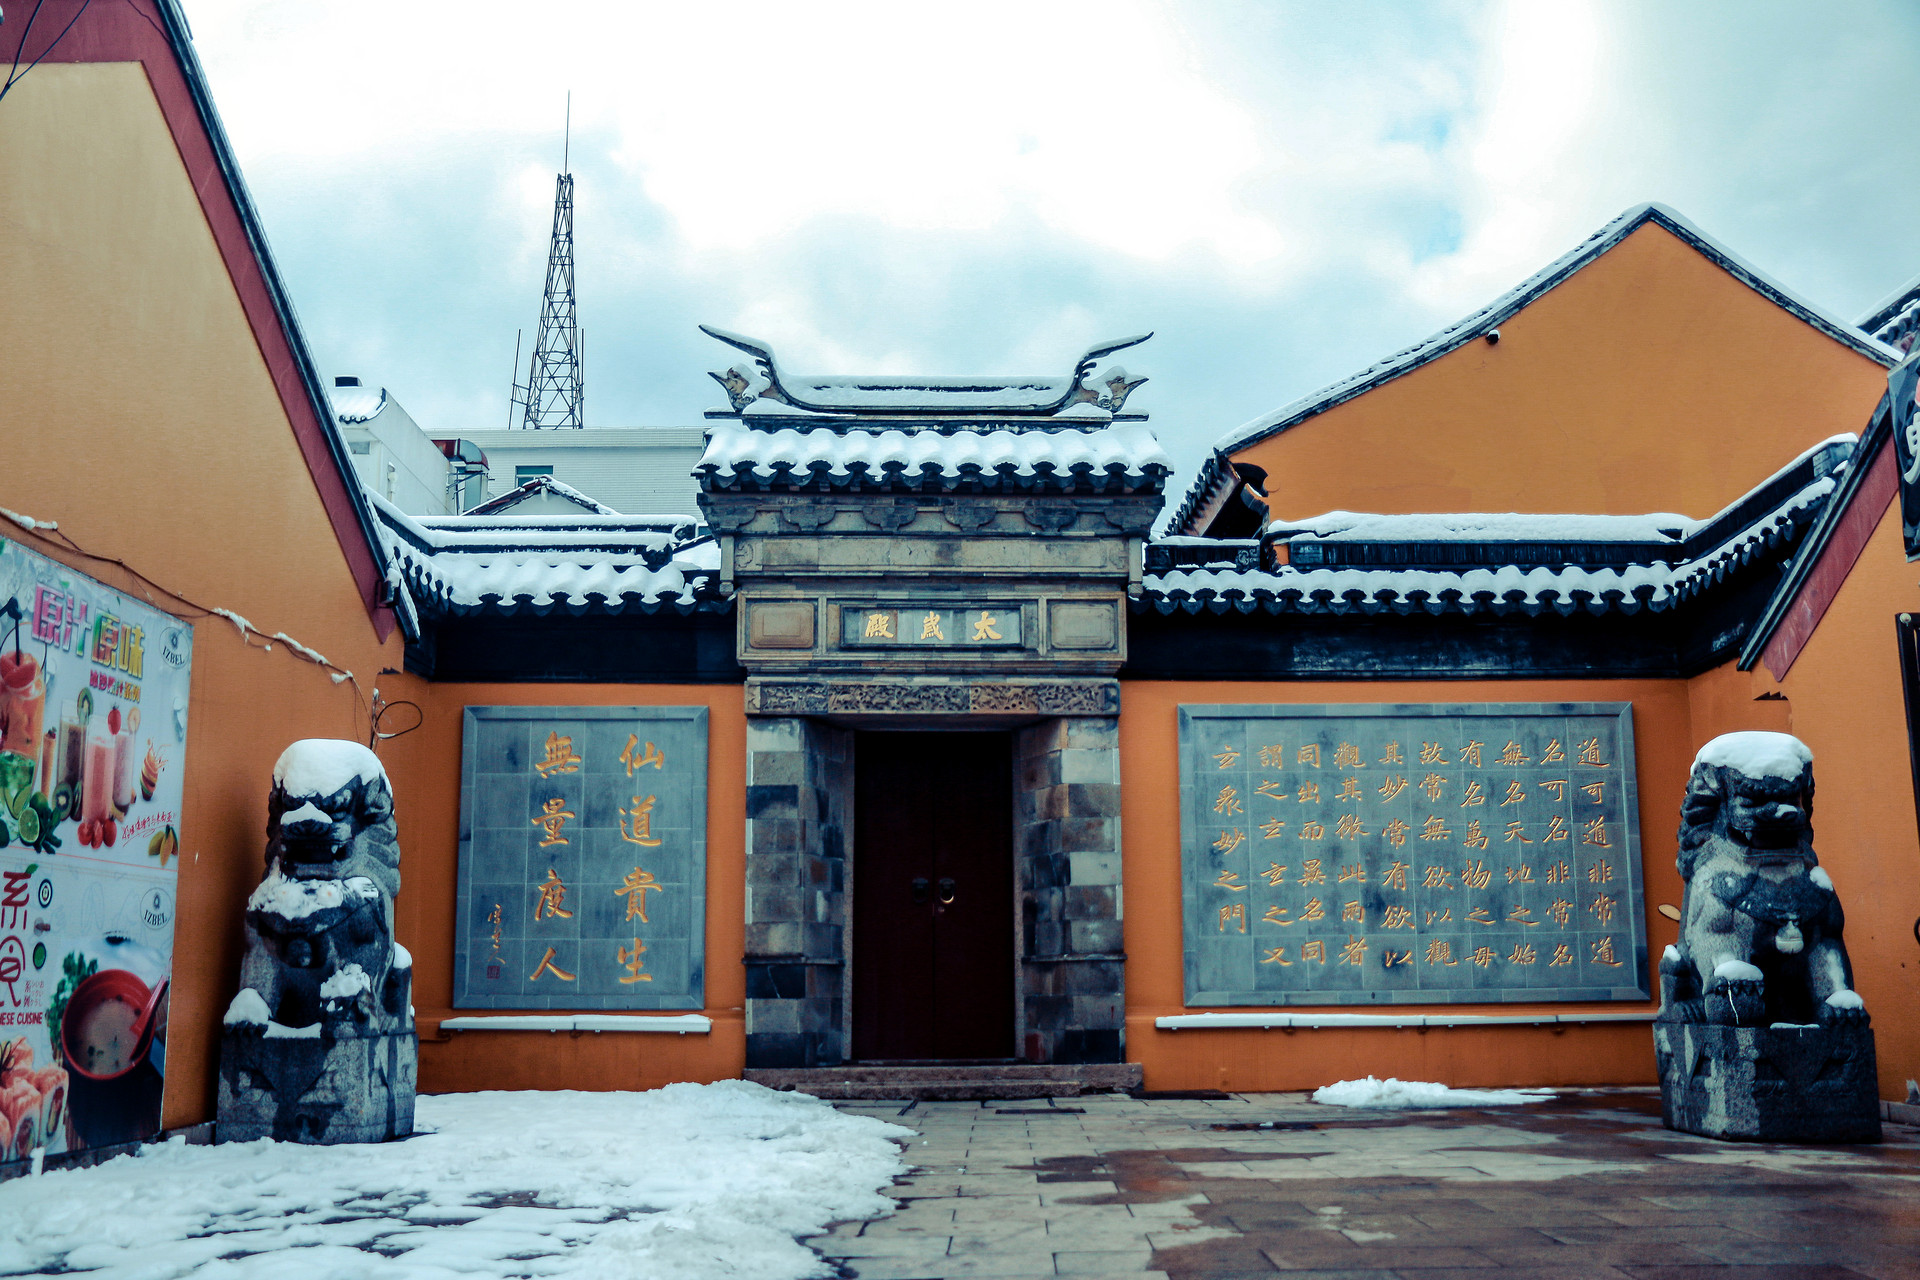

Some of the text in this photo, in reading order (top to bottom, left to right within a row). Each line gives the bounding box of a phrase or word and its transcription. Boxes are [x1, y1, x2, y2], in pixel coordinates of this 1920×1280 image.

[32, 583, 145, 680] 原汁原味
[530, 731, 582, 981] 無量度人
[615, 734, 664, 984] 仙道貴生
[1495, 740, 1539, 964] 無名天地之始
[1539, 739, 1573, 967] 名可名非常名
[1577, 737, 1623, 967] 道可道非常道
[0, 1012, 43, 1025] ESE CUISINE
